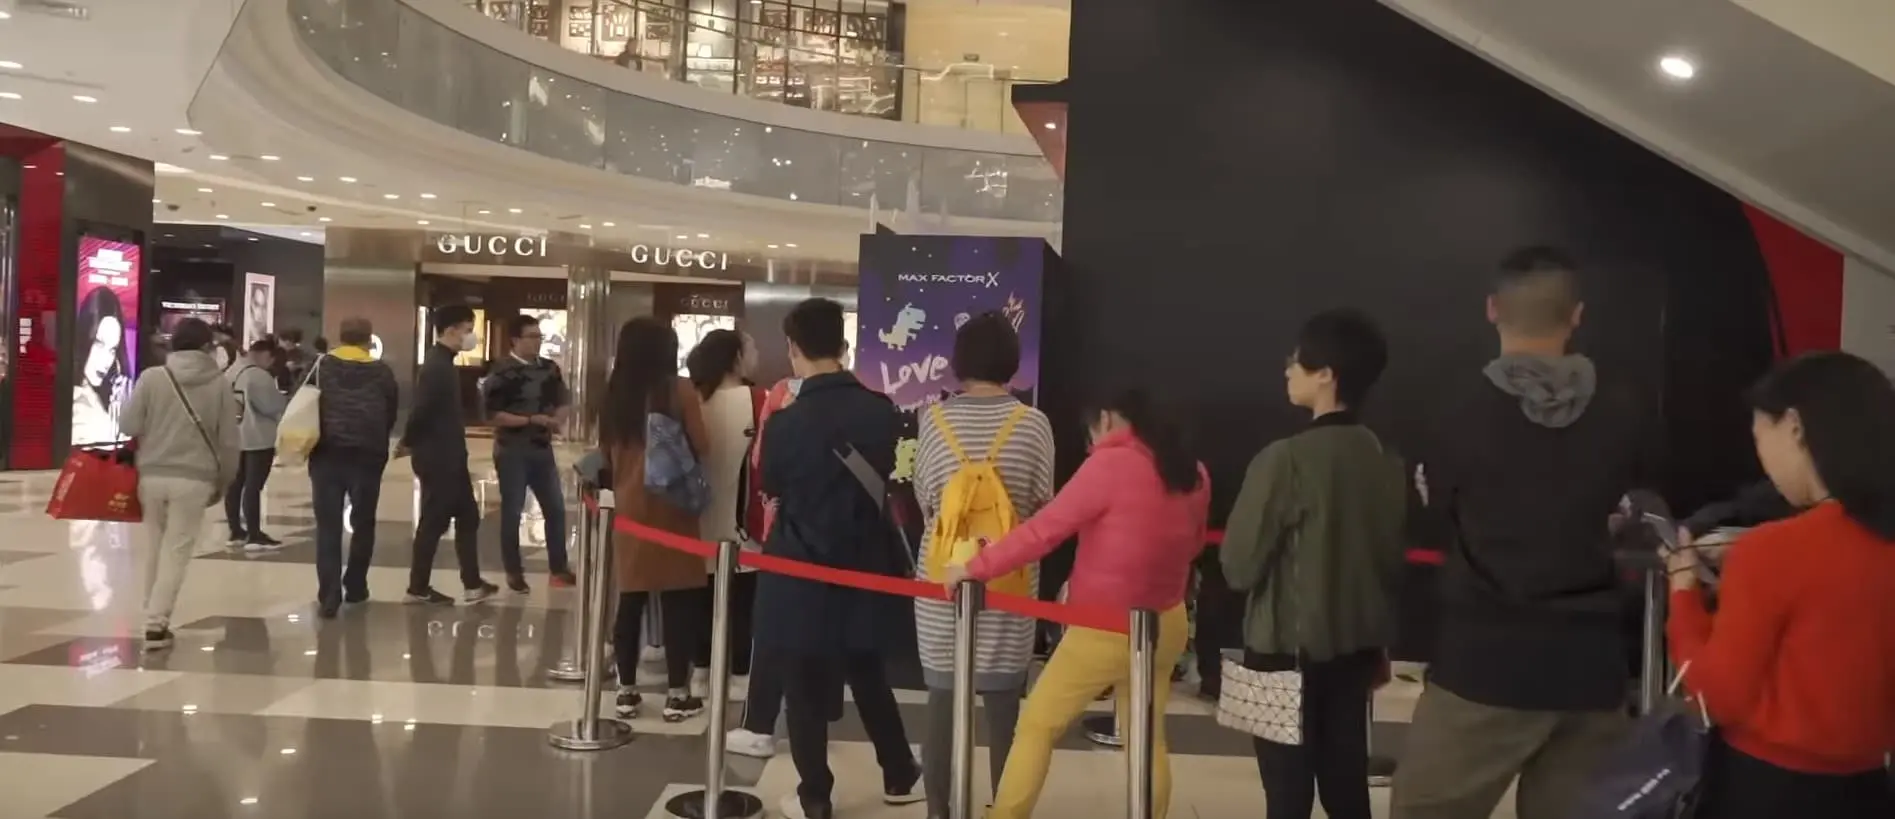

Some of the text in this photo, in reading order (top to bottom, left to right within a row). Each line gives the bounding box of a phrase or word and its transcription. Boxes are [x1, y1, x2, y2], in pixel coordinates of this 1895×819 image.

[437, 235, 547, 257] GUCCI
[631, 245, 728, 270] GUCCI
[898, 274, 928, 282] MAX
